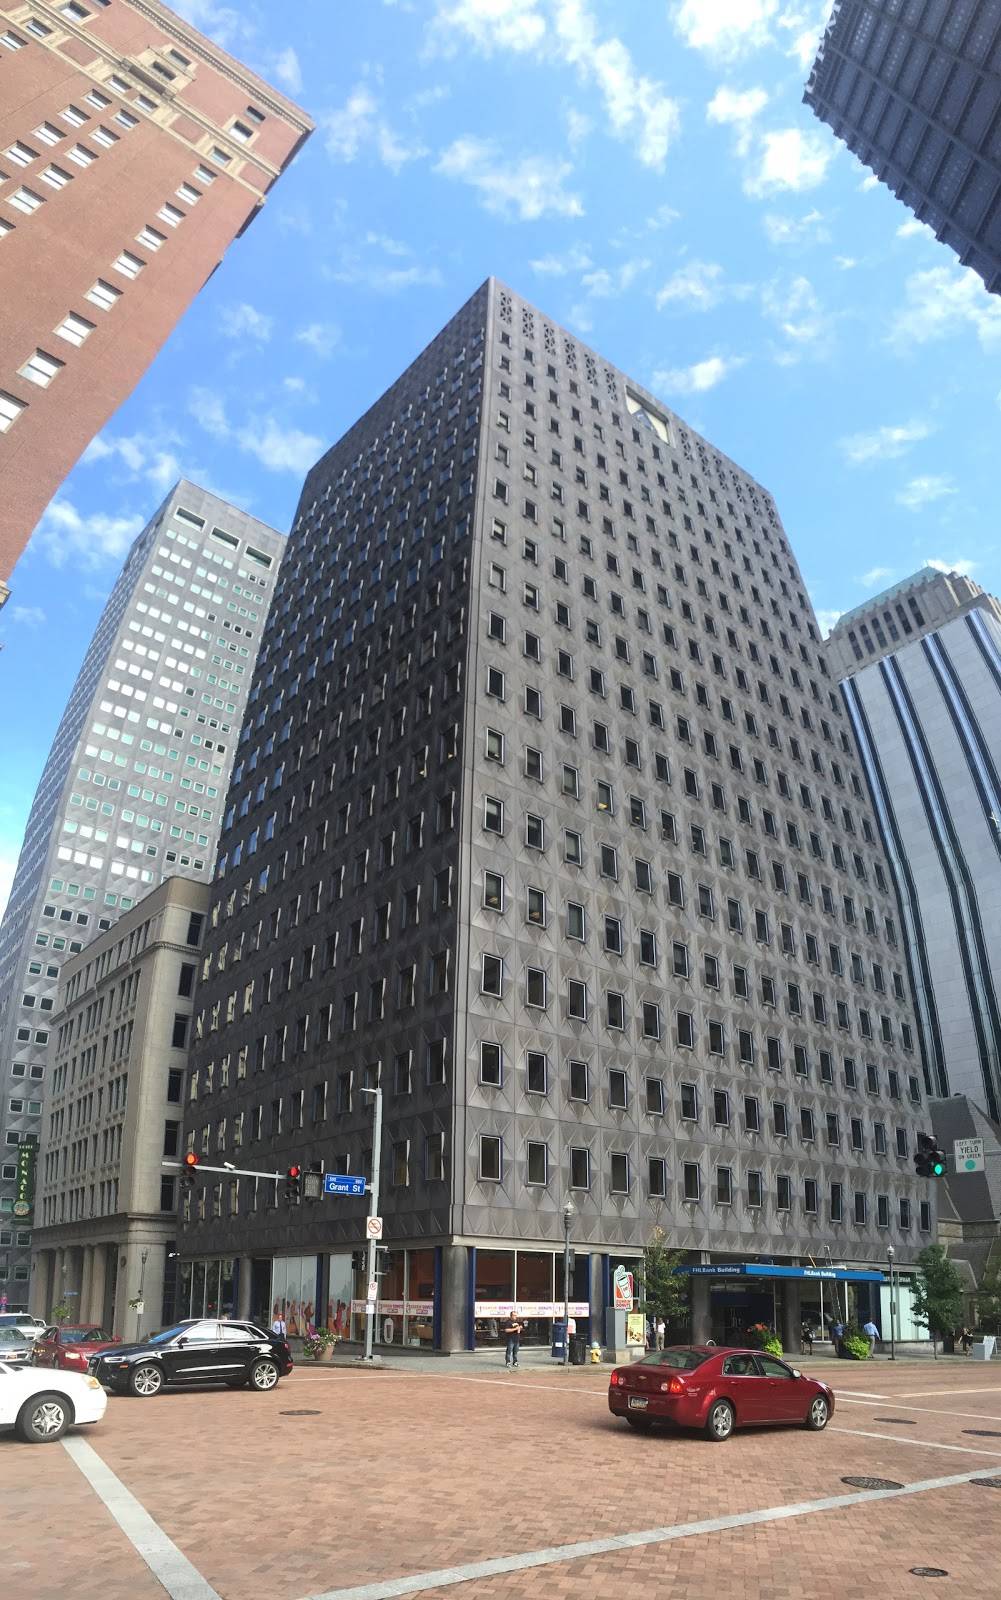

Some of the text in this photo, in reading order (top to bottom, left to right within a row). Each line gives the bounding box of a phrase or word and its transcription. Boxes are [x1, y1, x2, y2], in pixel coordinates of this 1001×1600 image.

[960, 1145, 979, 1154] YIELD
[20, 1152, 30, 1199] MONACO
[329, 1182, 349, 1192] Grant
[352, 1184, 361, 1193] St
